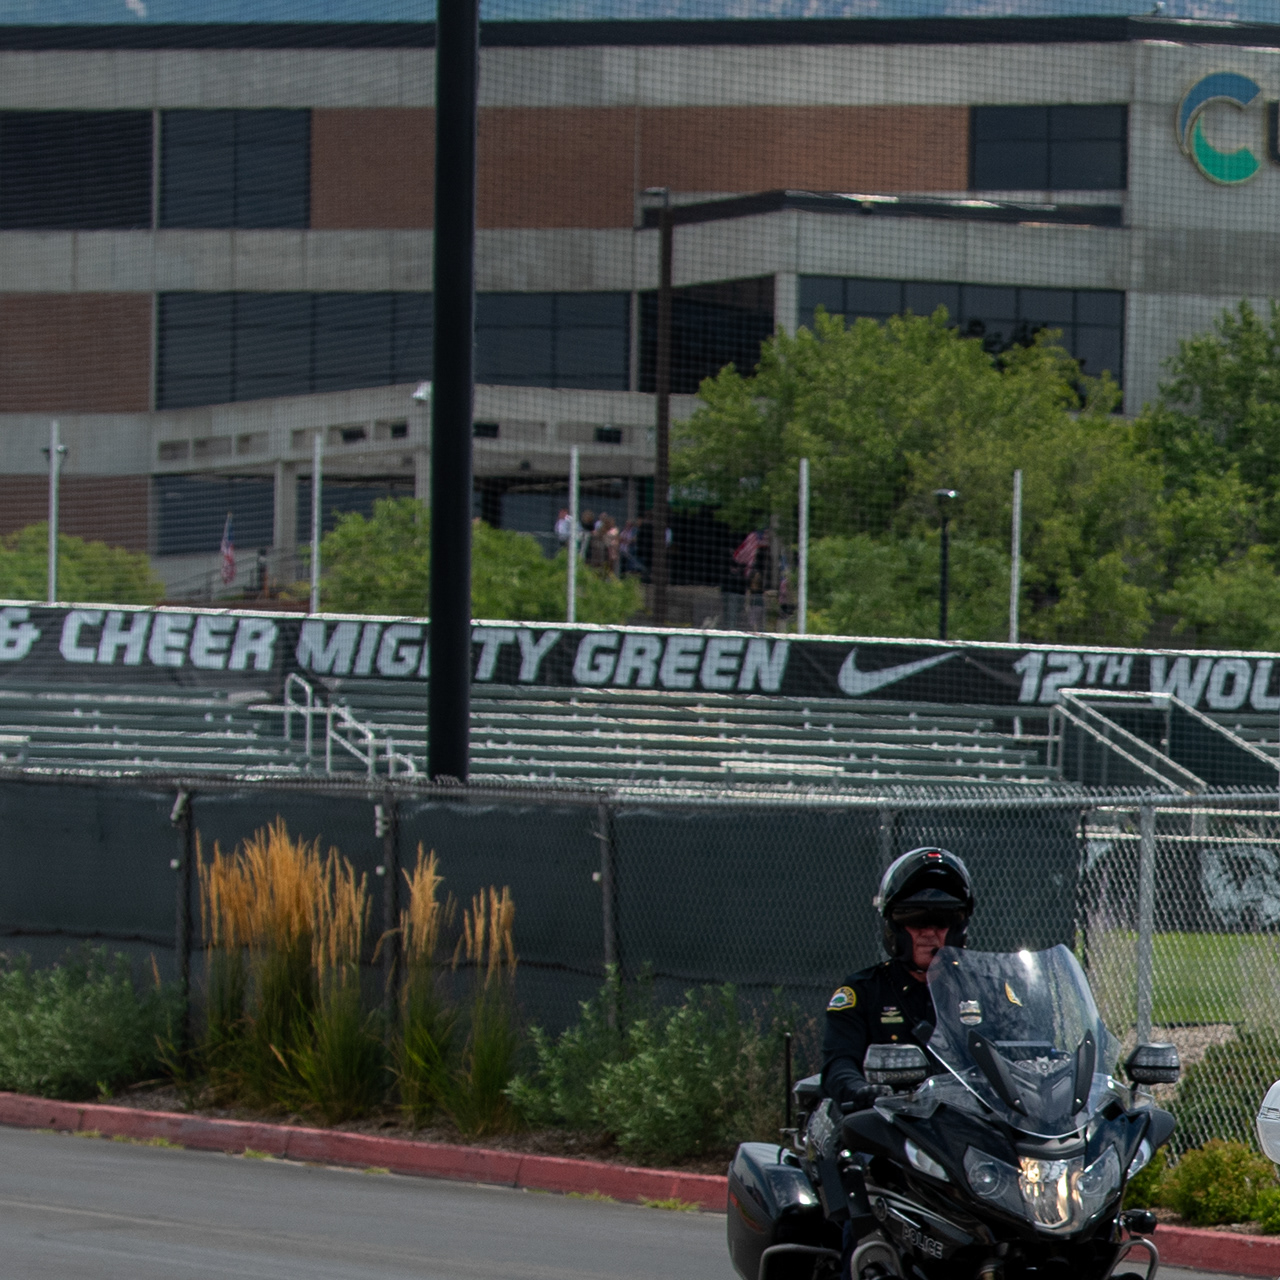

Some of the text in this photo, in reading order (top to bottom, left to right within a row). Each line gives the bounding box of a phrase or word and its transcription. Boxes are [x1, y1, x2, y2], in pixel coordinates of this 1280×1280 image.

[59, 610, 280, 672] CHEER
[295, 619, 792, 693] MIGTY GREEN
[1012, 651, 1134, 704] 12TH
[902, 1224, 944, 1260] POLICE
